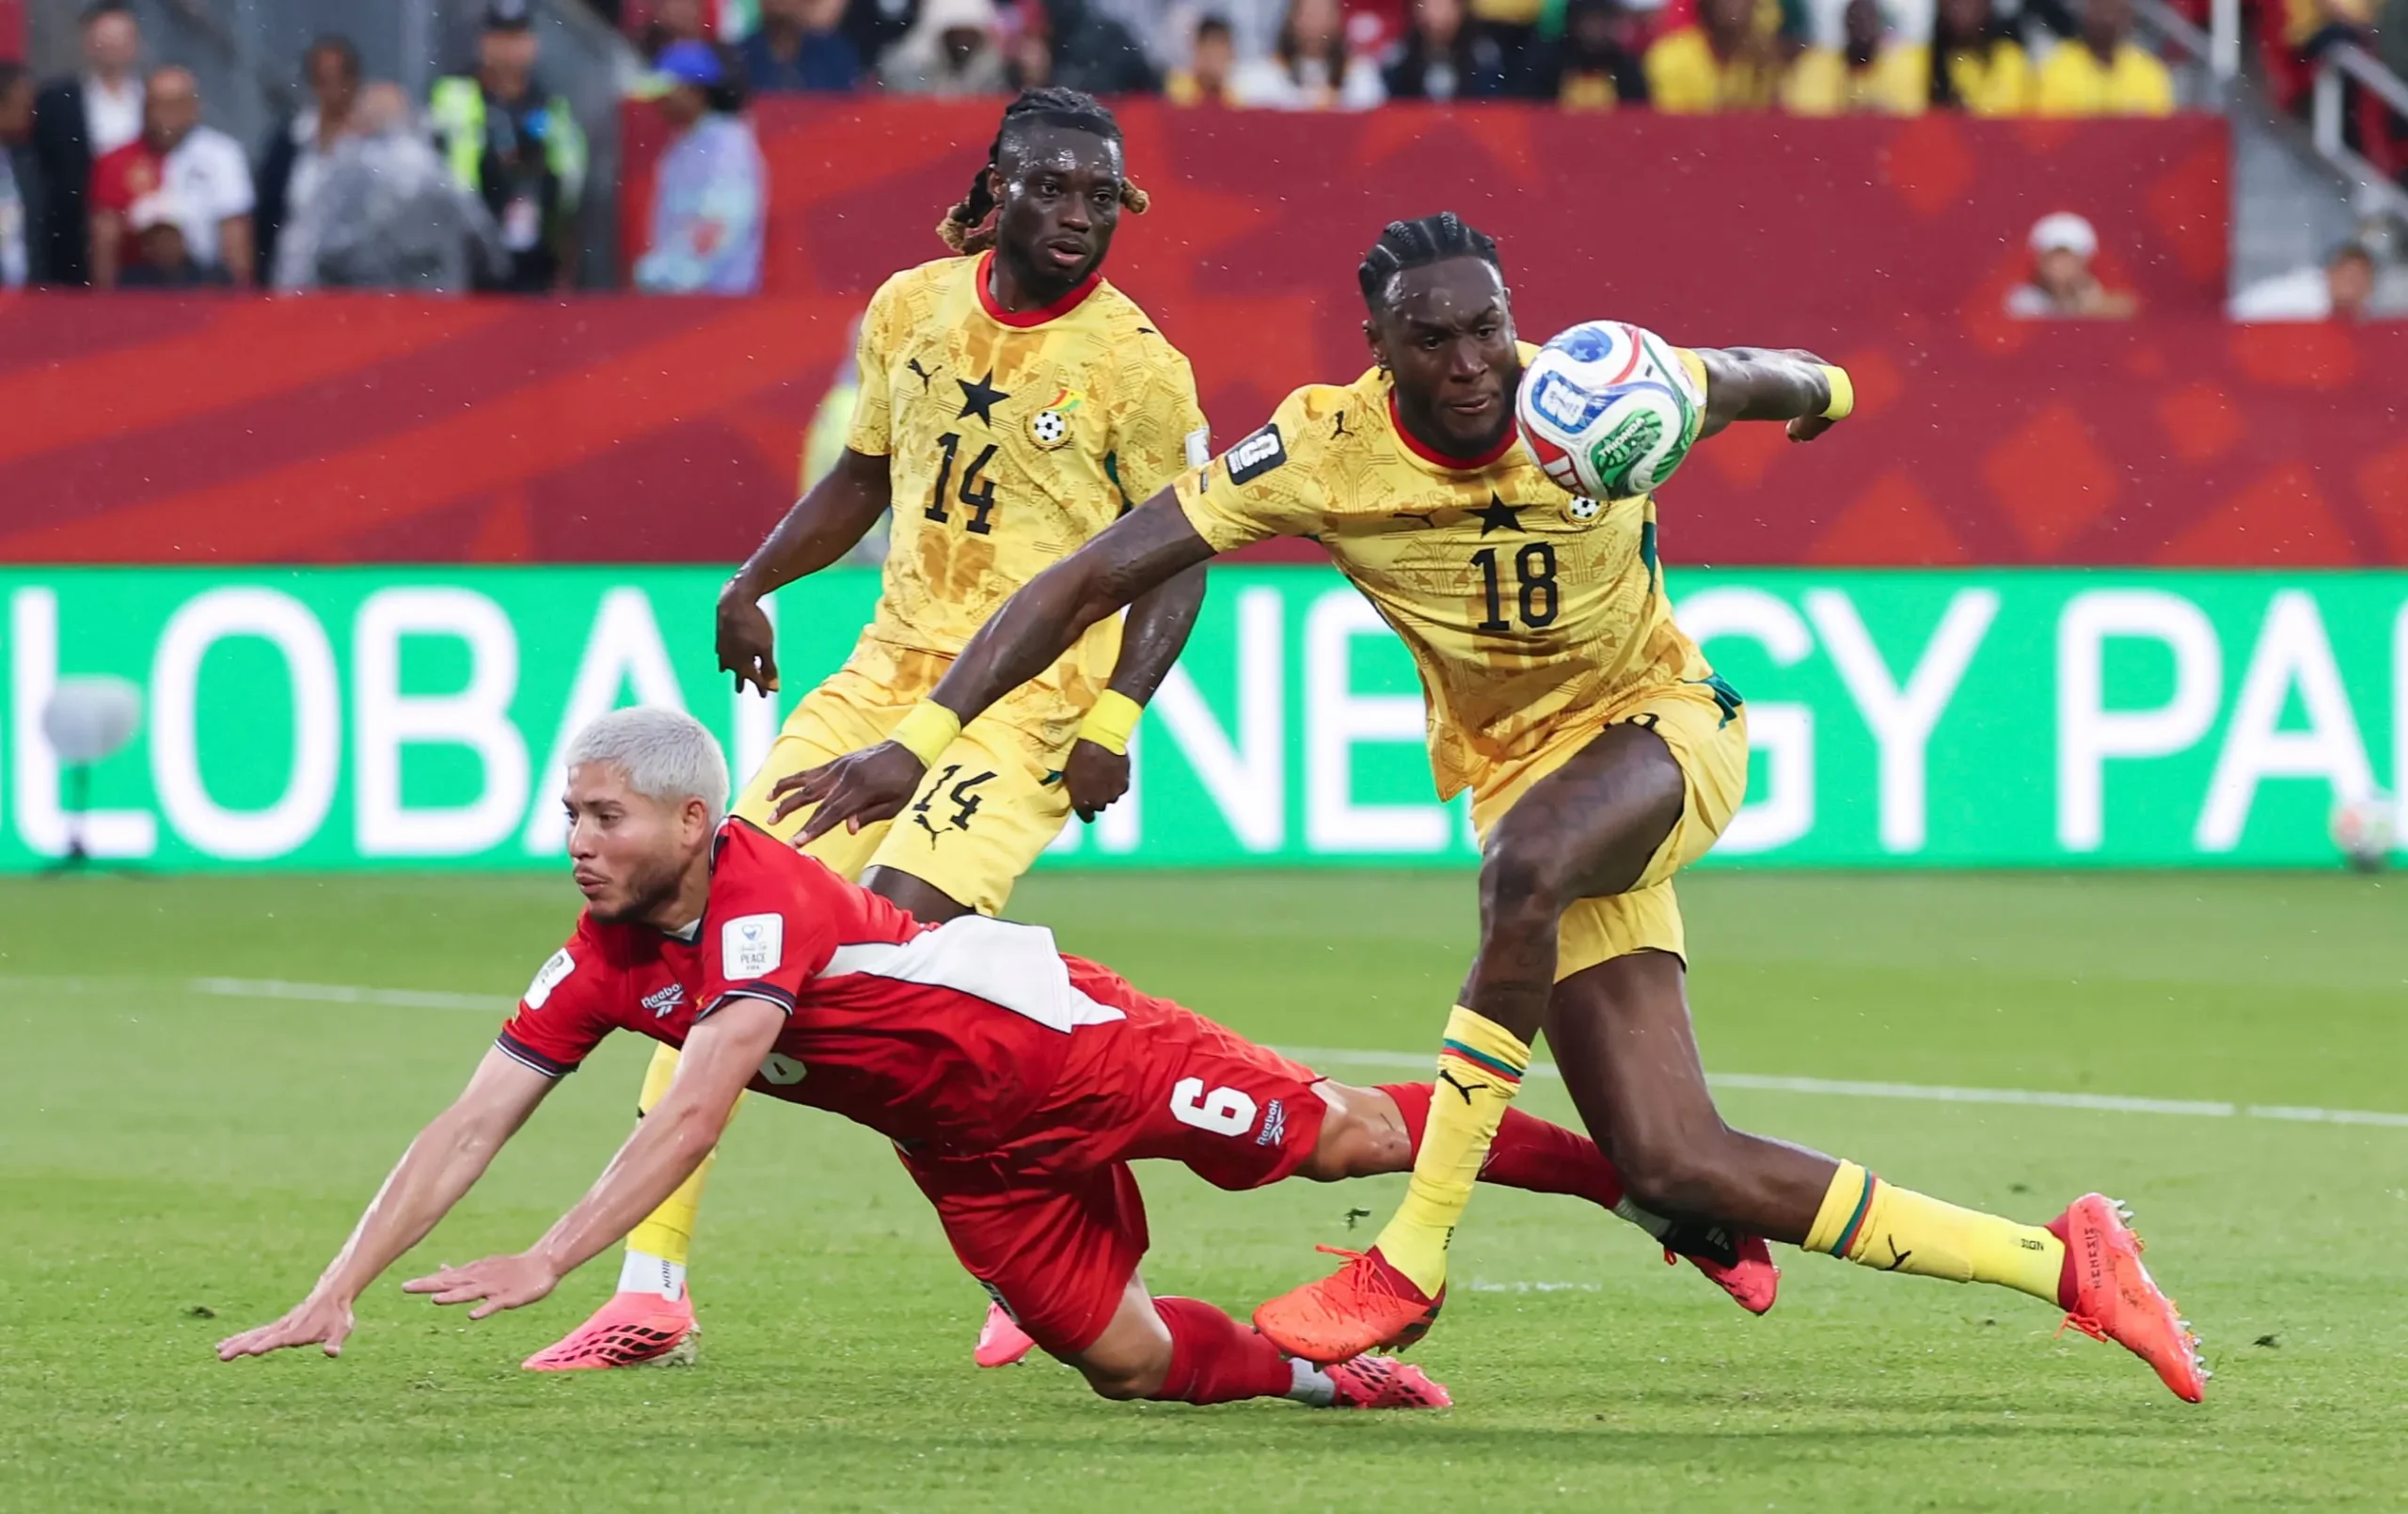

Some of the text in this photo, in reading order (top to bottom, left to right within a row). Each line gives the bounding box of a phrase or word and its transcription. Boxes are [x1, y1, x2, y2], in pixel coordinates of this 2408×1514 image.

[1598, 418, 1644, 457] TRIONDA
[925, 432, 999, 535] 14
[1470, 541, 1558, 631] 18
[2057, 587, 2408, 852] PA
[911, 765, 998, 830] 14
[641, 982, 683, 1008] Reebo
[1169, 1076, 1259, 1137] 6
[1256, 1099, 1280, 1145] Reebok
